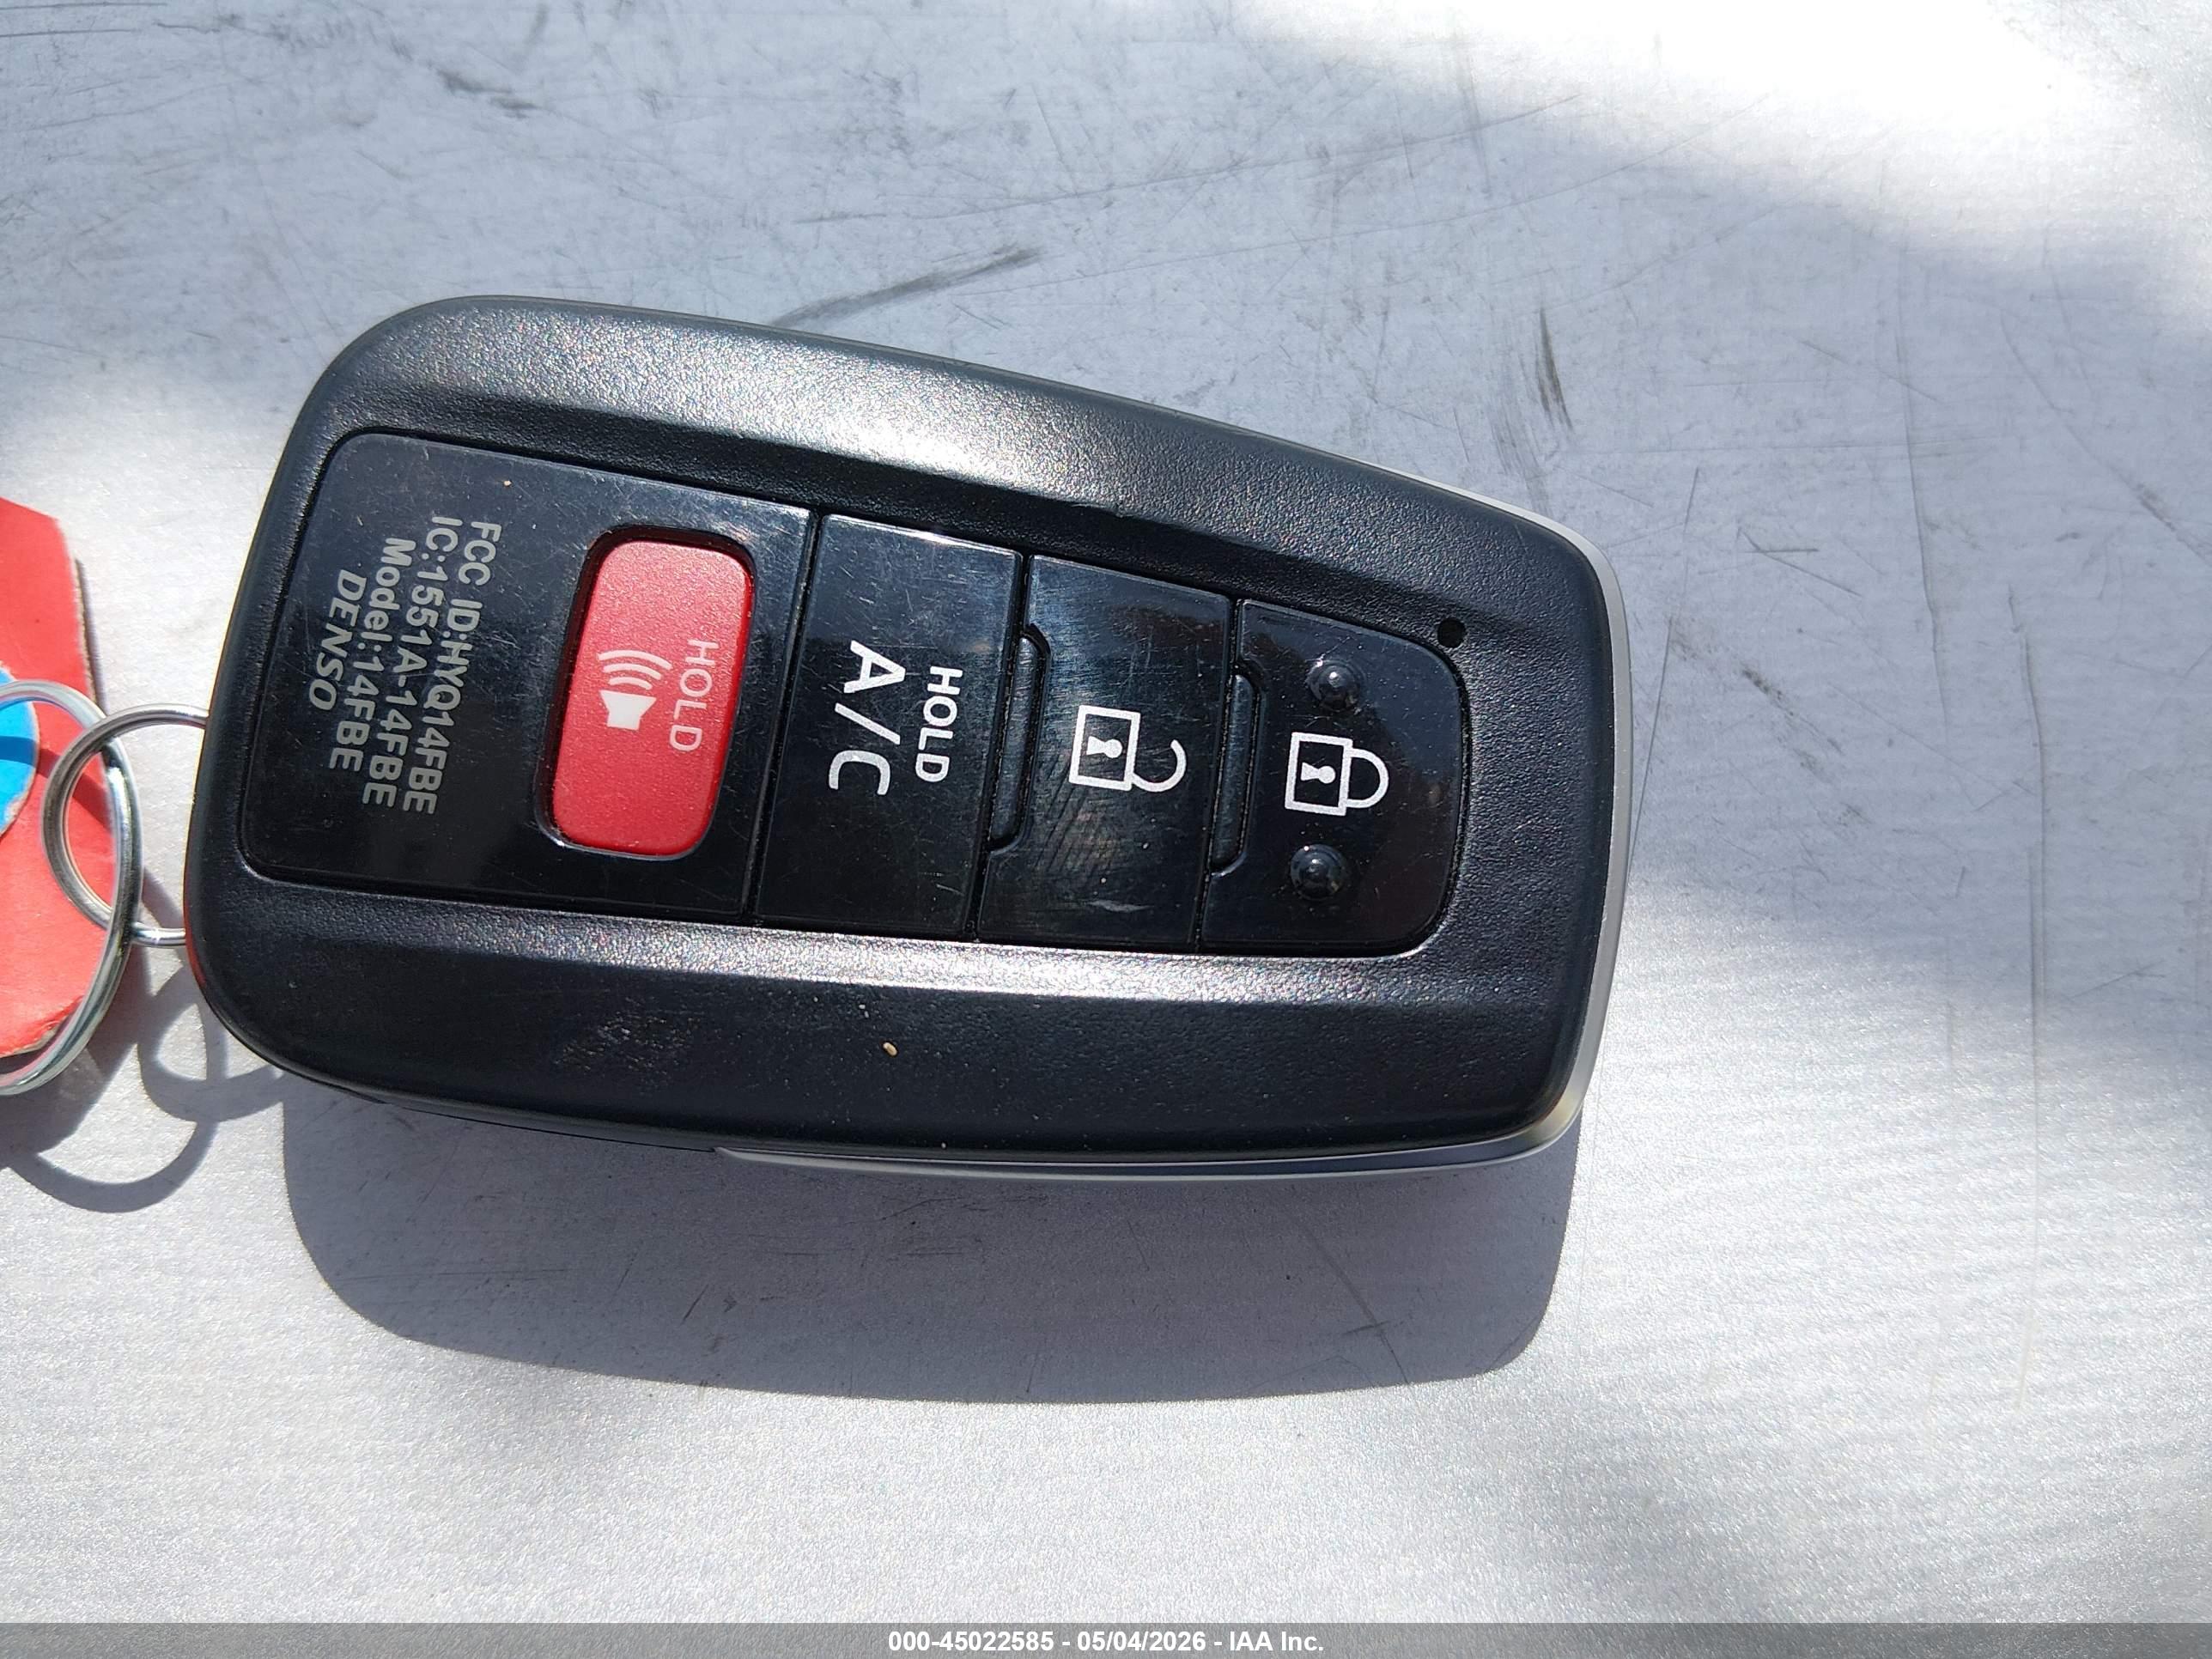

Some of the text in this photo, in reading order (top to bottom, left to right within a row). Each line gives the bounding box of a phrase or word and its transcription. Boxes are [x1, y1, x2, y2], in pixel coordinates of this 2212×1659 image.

[308, 569, 367, 711] DENSO
[329, 538, 416, 771] Model:14FBE
[362, 516, 463, 808] IC:1551A-14FBE
[403, 521, 501, 814] FCC ID:HYQ14FBE
[669, 640, 720, 752] HOLD
[829, 640, 906, 795] A/C
[915, 665, 963, 782] HOLD
